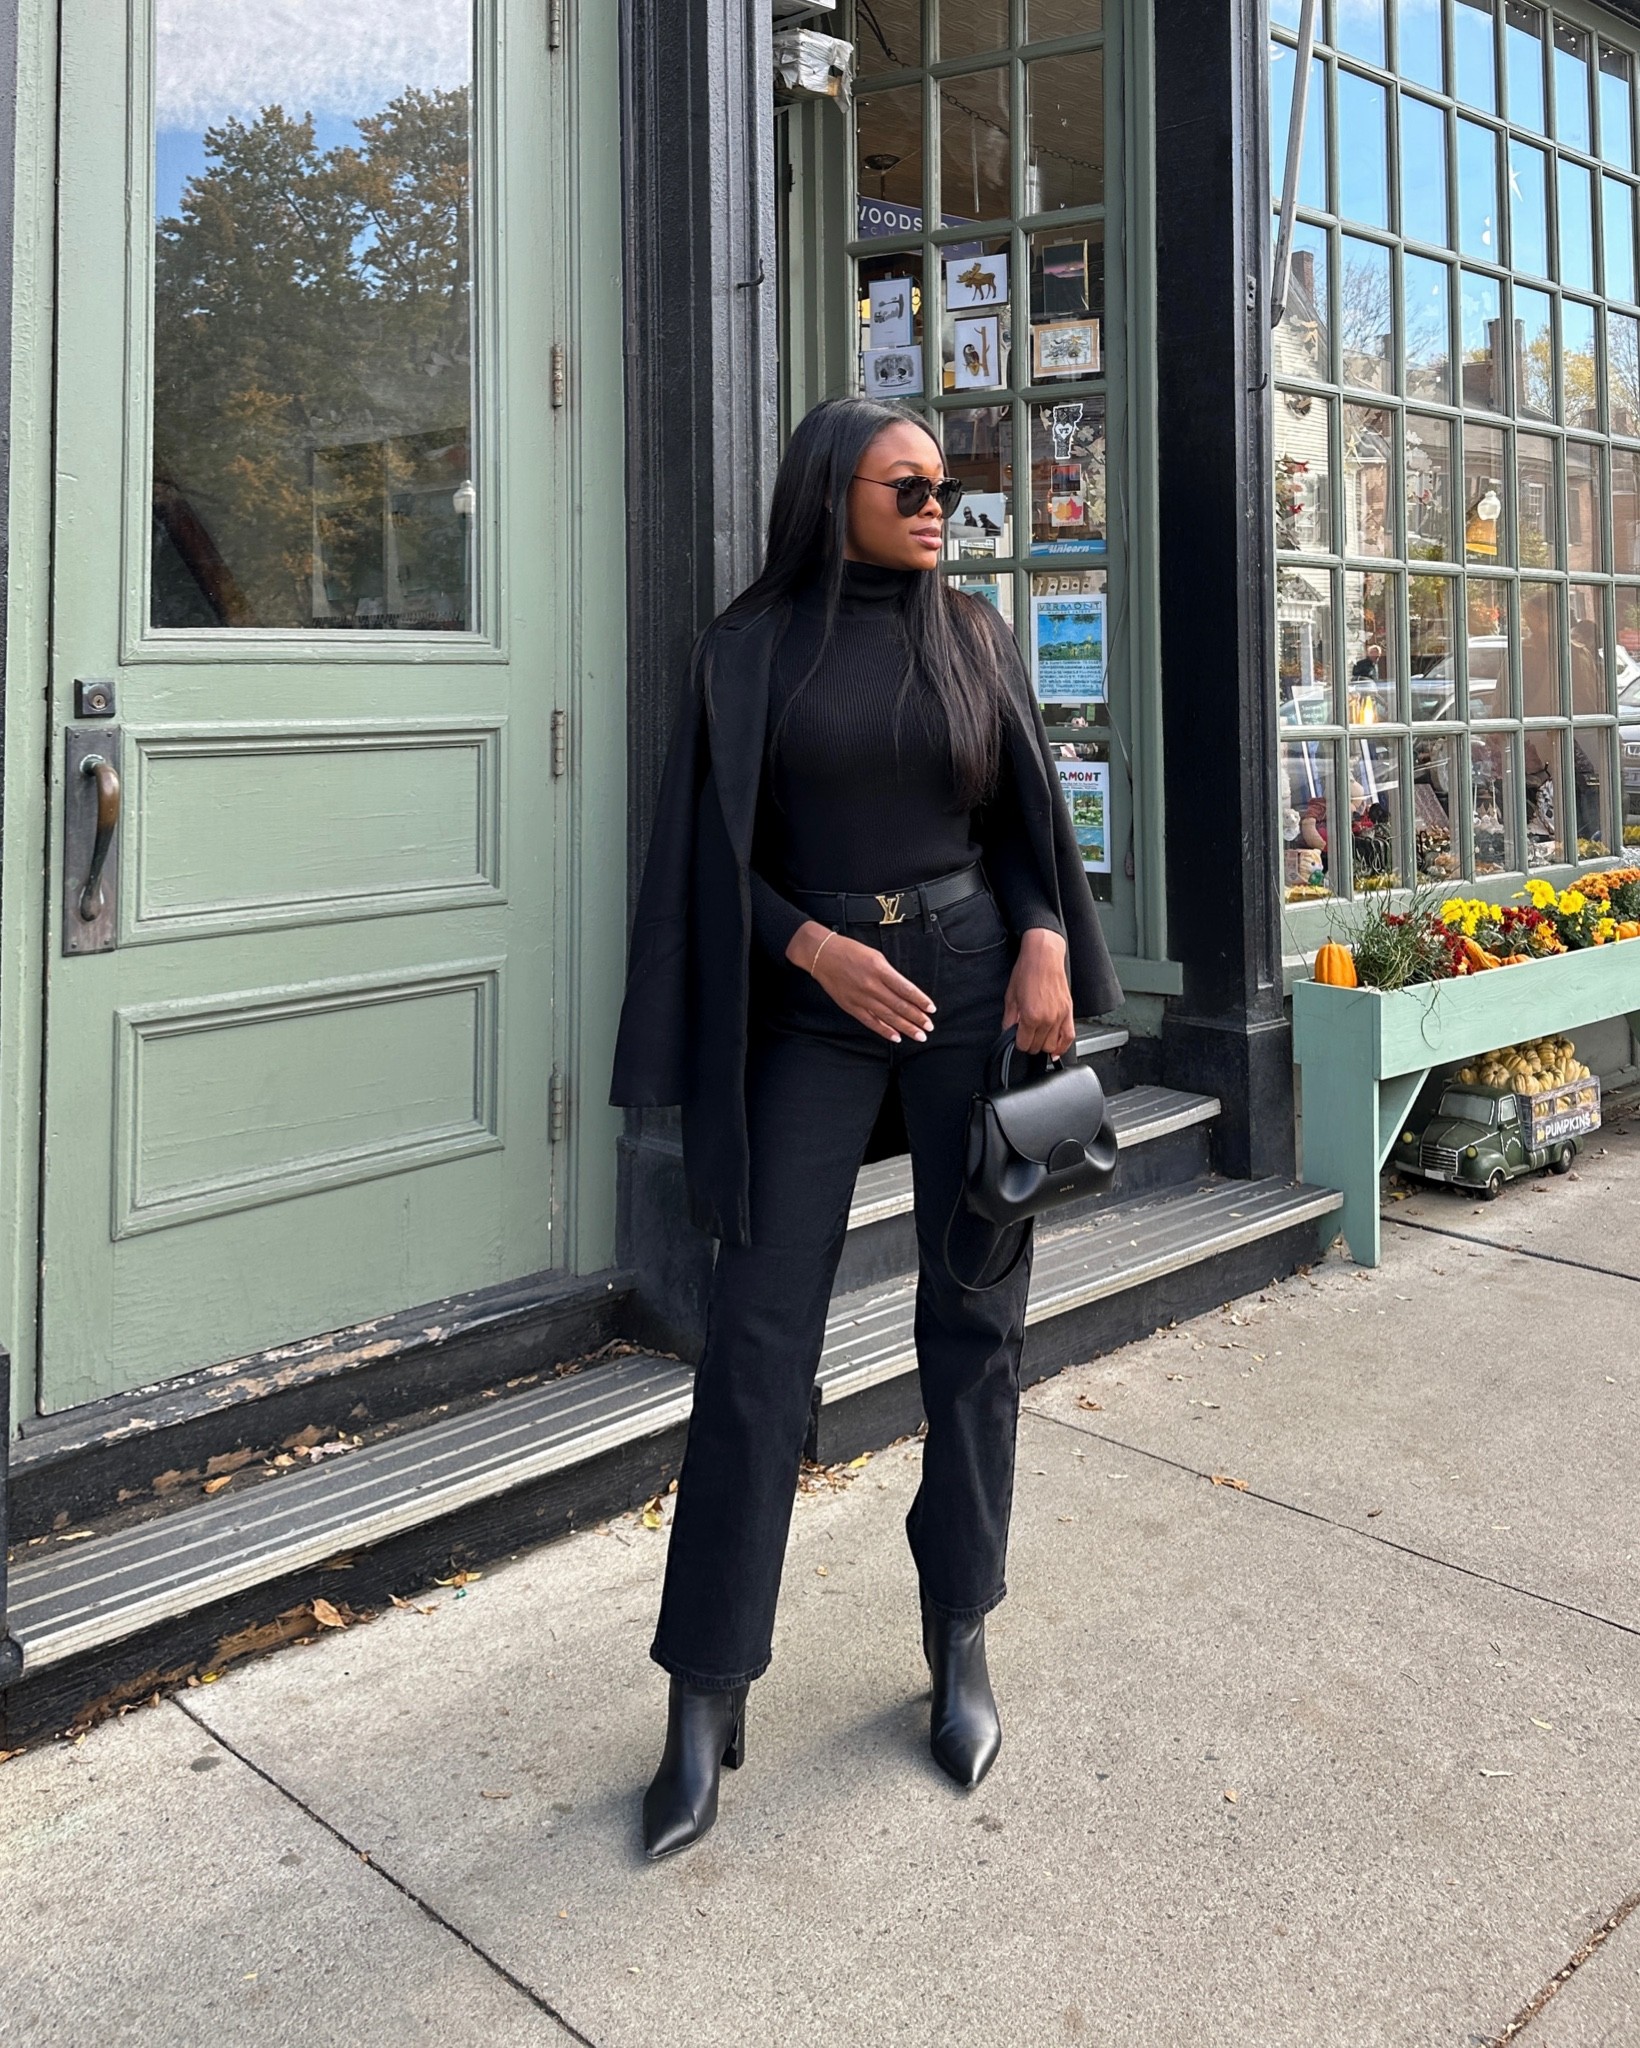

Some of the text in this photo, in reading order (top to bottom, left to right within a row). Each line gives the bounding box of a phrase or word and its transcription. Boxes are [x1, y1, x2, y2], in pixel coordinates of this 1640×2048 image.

[1039, 602, 1100, 610] VERMONT
[1060, 771, 1101, 781] RMONT
[1545, 1112, 1591, 1139] PUMPKINS
